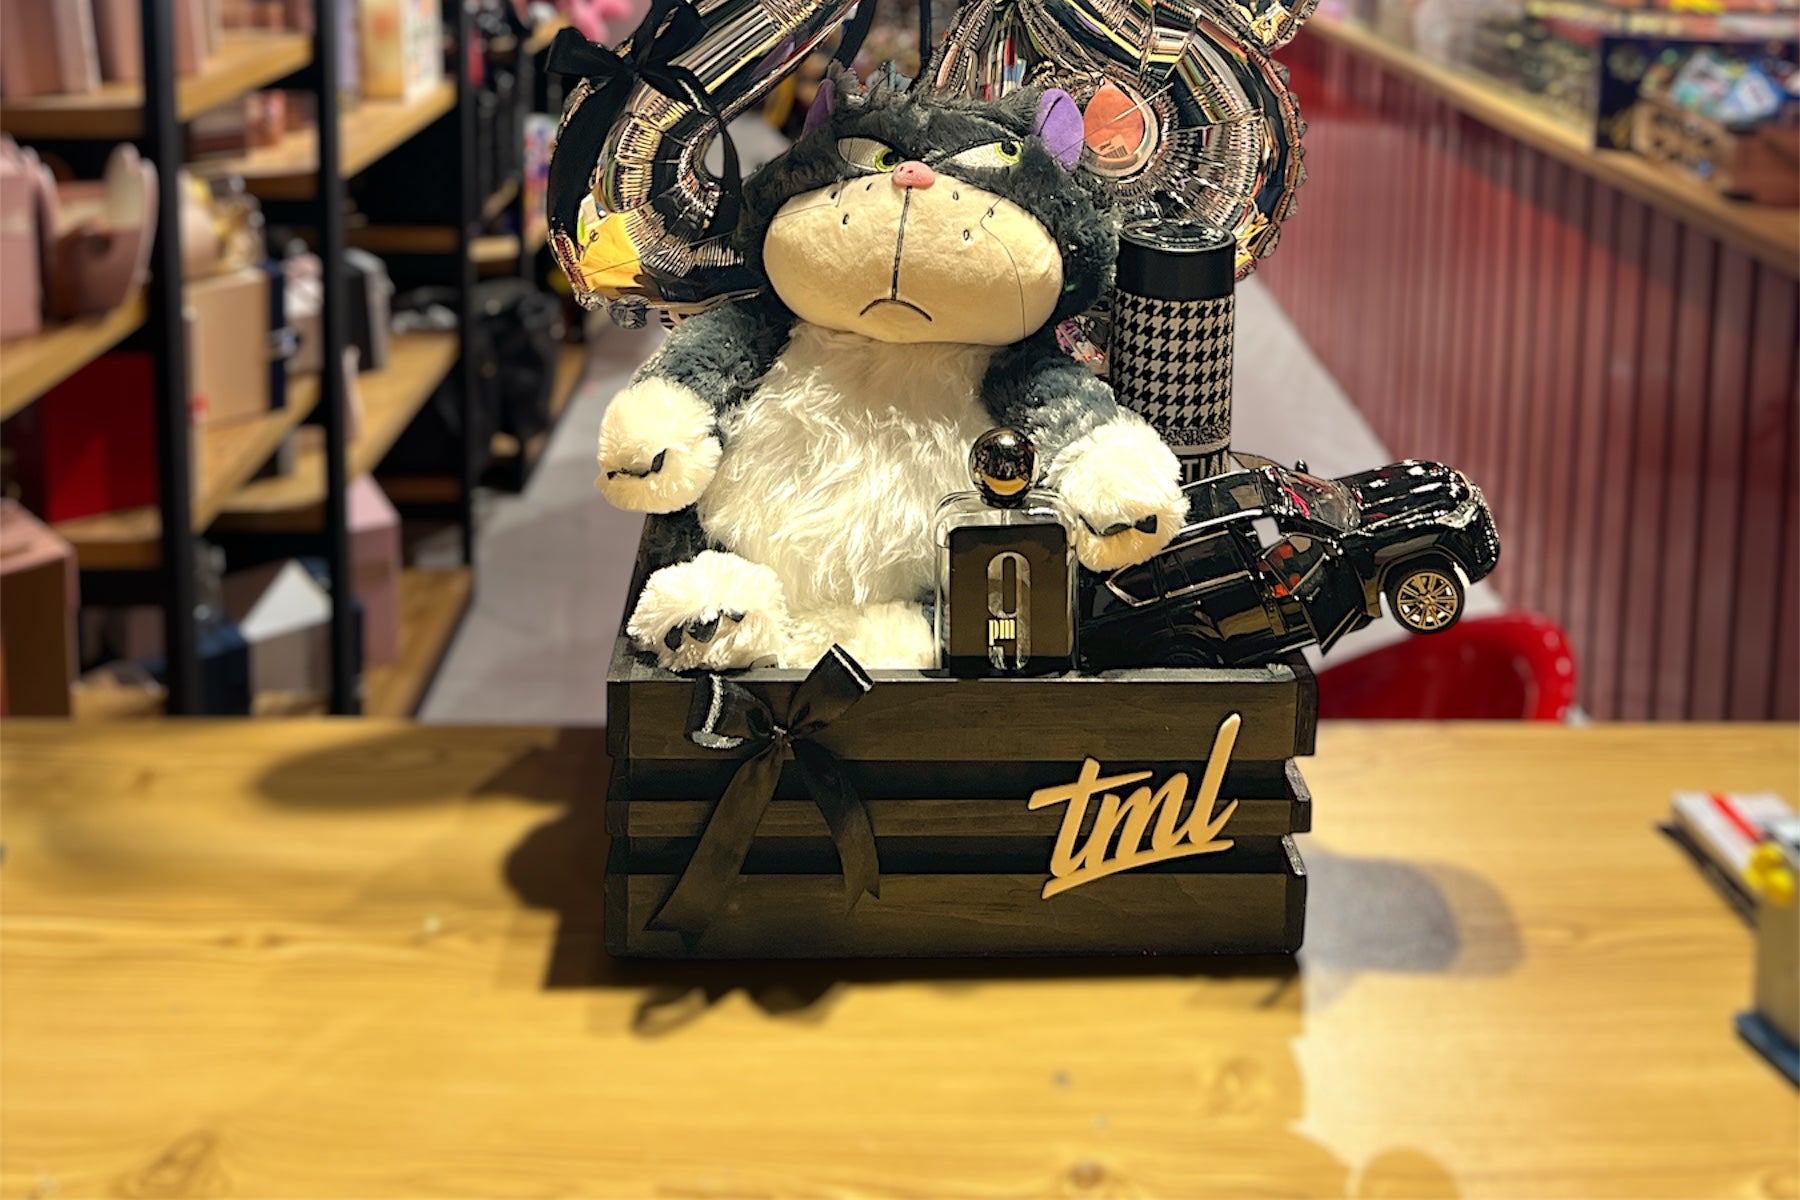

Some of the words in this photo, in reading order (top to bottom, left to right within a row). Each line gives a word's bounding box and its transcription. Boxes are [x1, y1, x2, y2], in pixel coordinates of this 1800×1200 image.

[987, 551, 1031, 671] 9
[988, 619, 1016, 647] pm
[1027, 712, 1242, 900] tml
